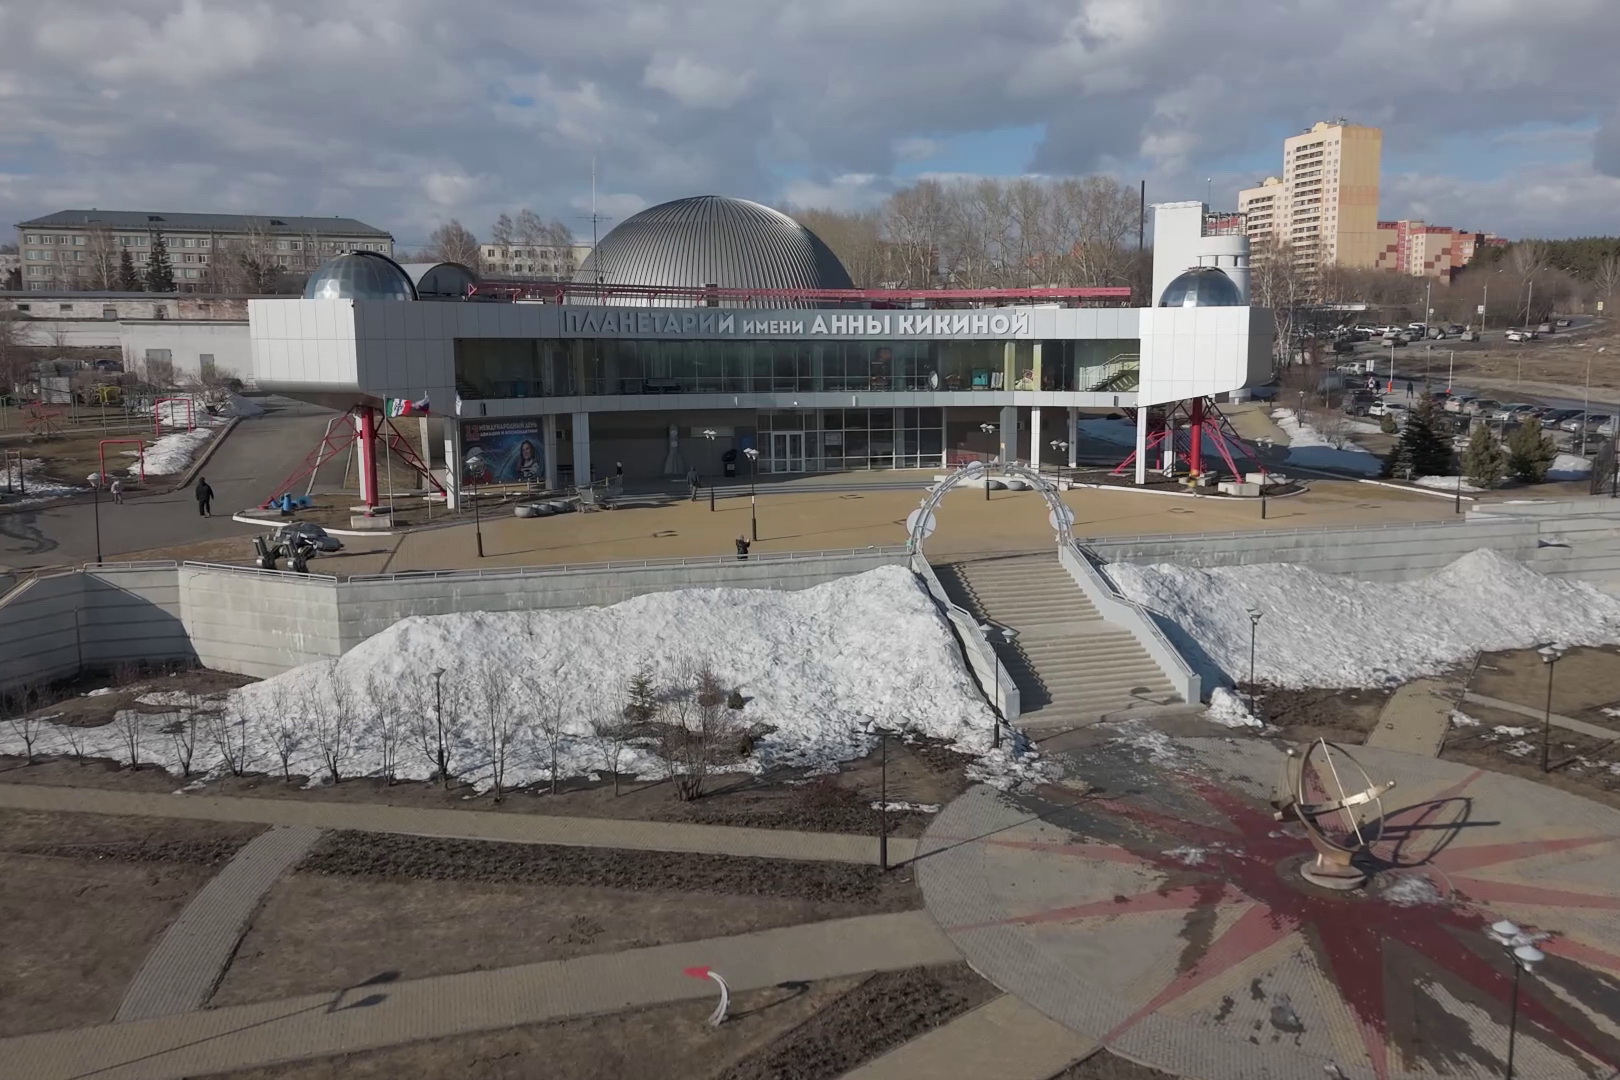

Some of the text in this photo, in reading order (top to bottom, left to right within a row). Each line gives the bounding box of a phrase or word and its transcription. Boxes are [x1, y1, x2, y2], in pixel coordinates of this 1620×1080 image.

[564, 310, 1030, 335] ПЛАНЕТАРИЙ ИМЕНИ АННЫ КИКИНОЙ
